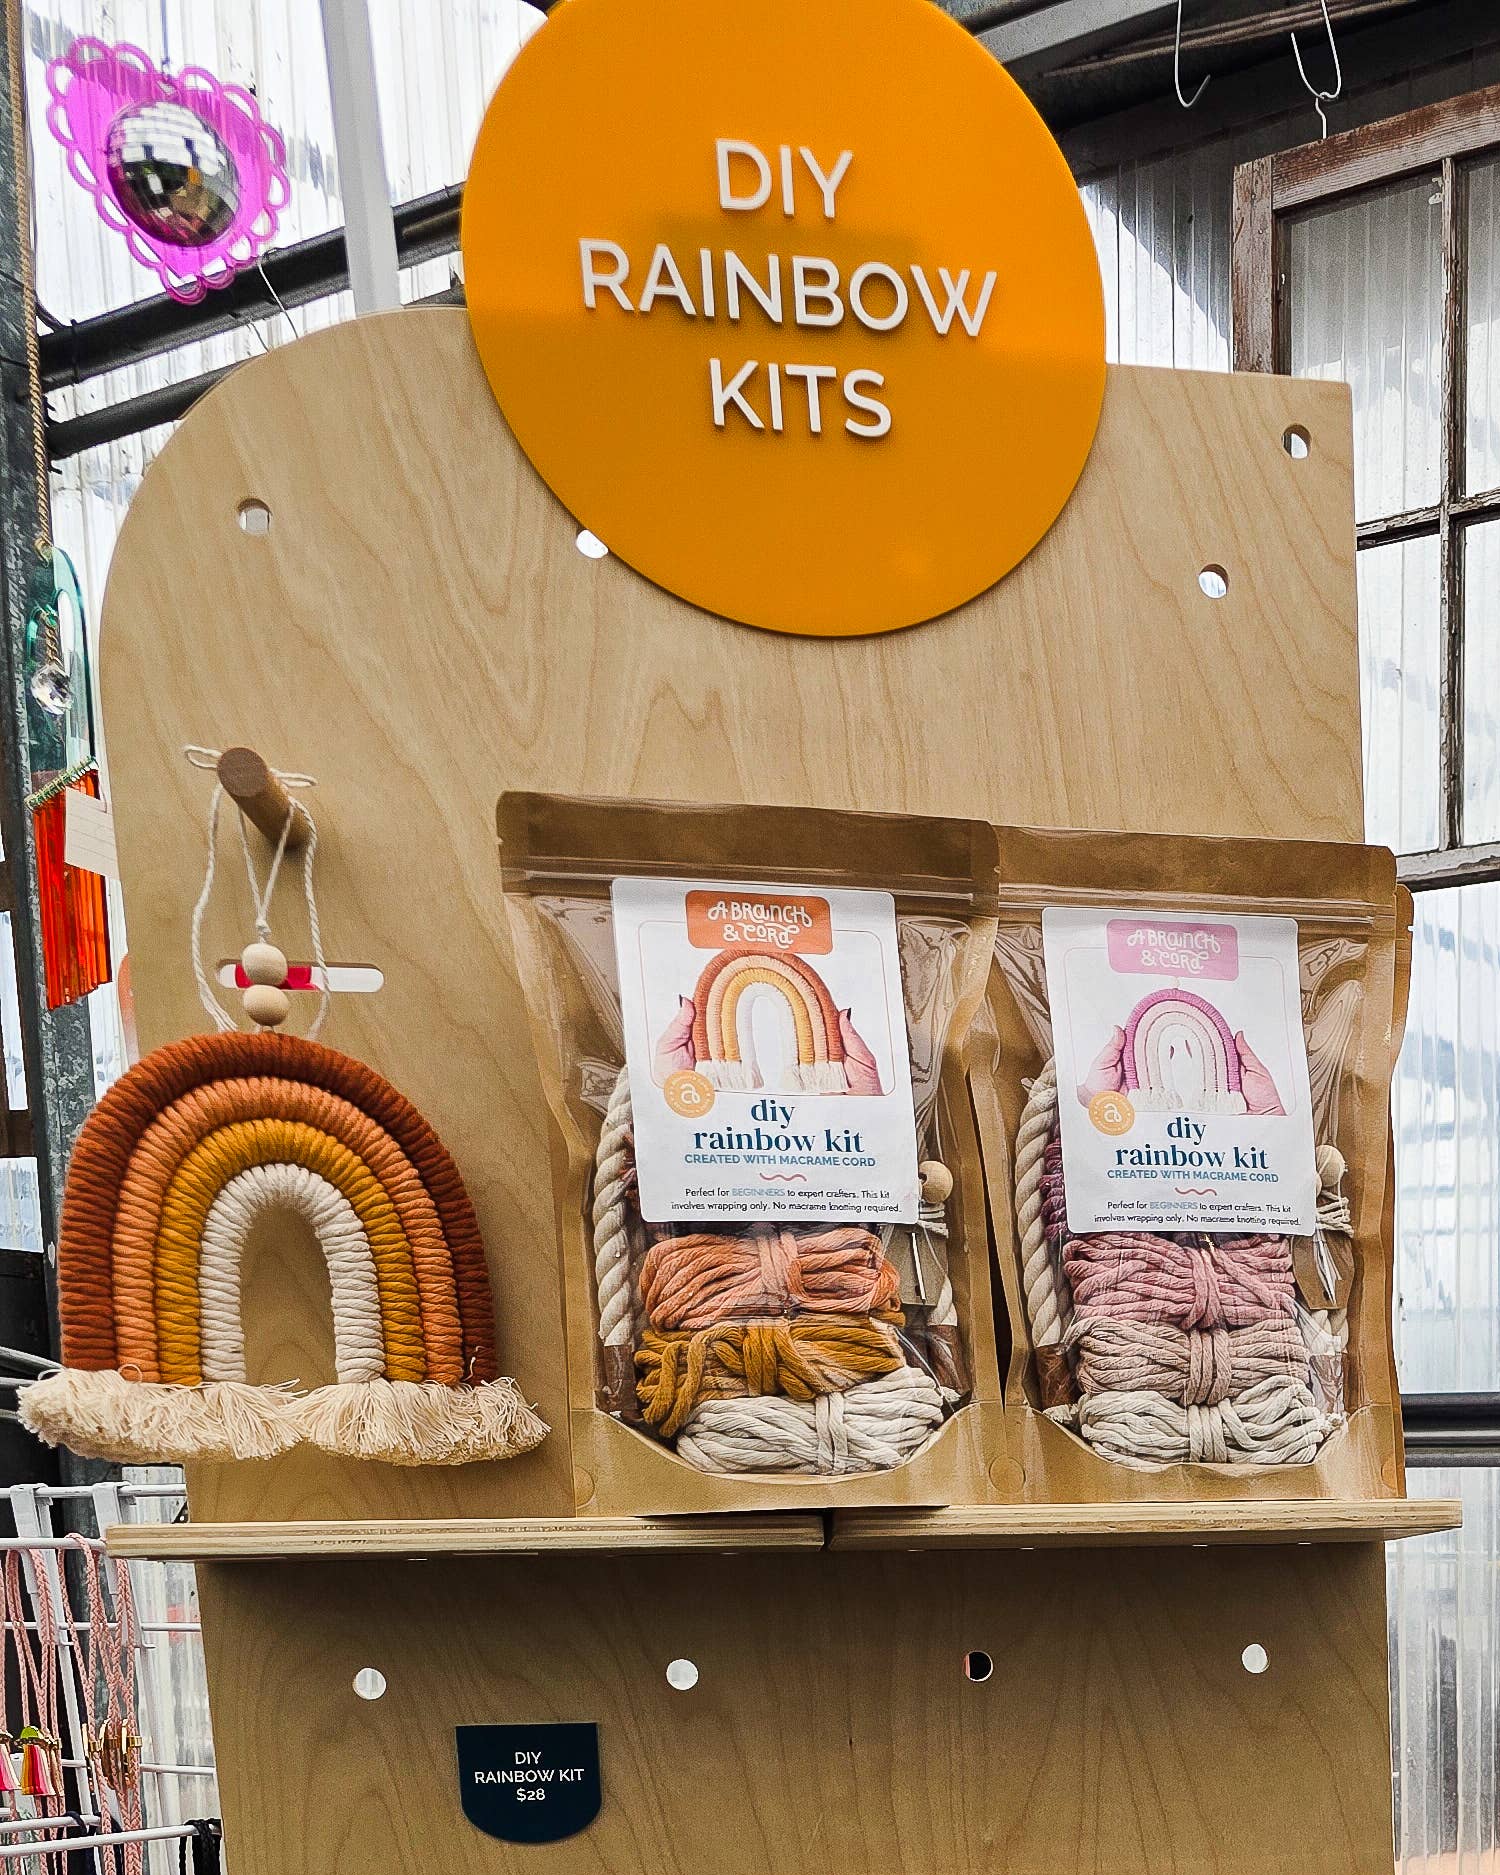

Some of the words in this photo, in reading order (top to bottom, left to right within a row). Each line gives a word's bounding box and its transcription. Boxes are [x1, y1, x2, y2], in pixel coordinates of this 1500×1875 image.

[716, 139, 851, 218] DIY
[579, 239, 997, 336] RAINBOW
[709, 359, 892, 437] KITS
[723, 926, 740, 941] &
[1141, 951, 1155, 966] &
[751, 1100, 796, 1128] diy
[693, 1127, 816, 1151] rainbow
[824, 1130, 865, 1152] kit
[1166, 1117, 1206, 1145] diy
[685, 1154, 740, 1164] CREATED
[743, 1155, 776, 1165] WITH
[779, 1156, 840, 1166] MACRAME
[842, 1157, 876, 1167] CORD
[1115, 1144, 1226, 1167] rainbow
[1234, 1147, 1269, 1169] kit
[1107, 1170, 1158, 1179] CREATED
[1161, 1170, 1190, 1180] WITH
[1193, 1171, 1247, 1181] MACRAME
[1250, 1173, 1279, 1183] CORD
[515, 1752, 541, 1764] DIY
[475, 1770, 554, 1783] RAINBOW
[559, 1769, 584, 1782] KIT
[517, 1788, 545, 1802] $28
